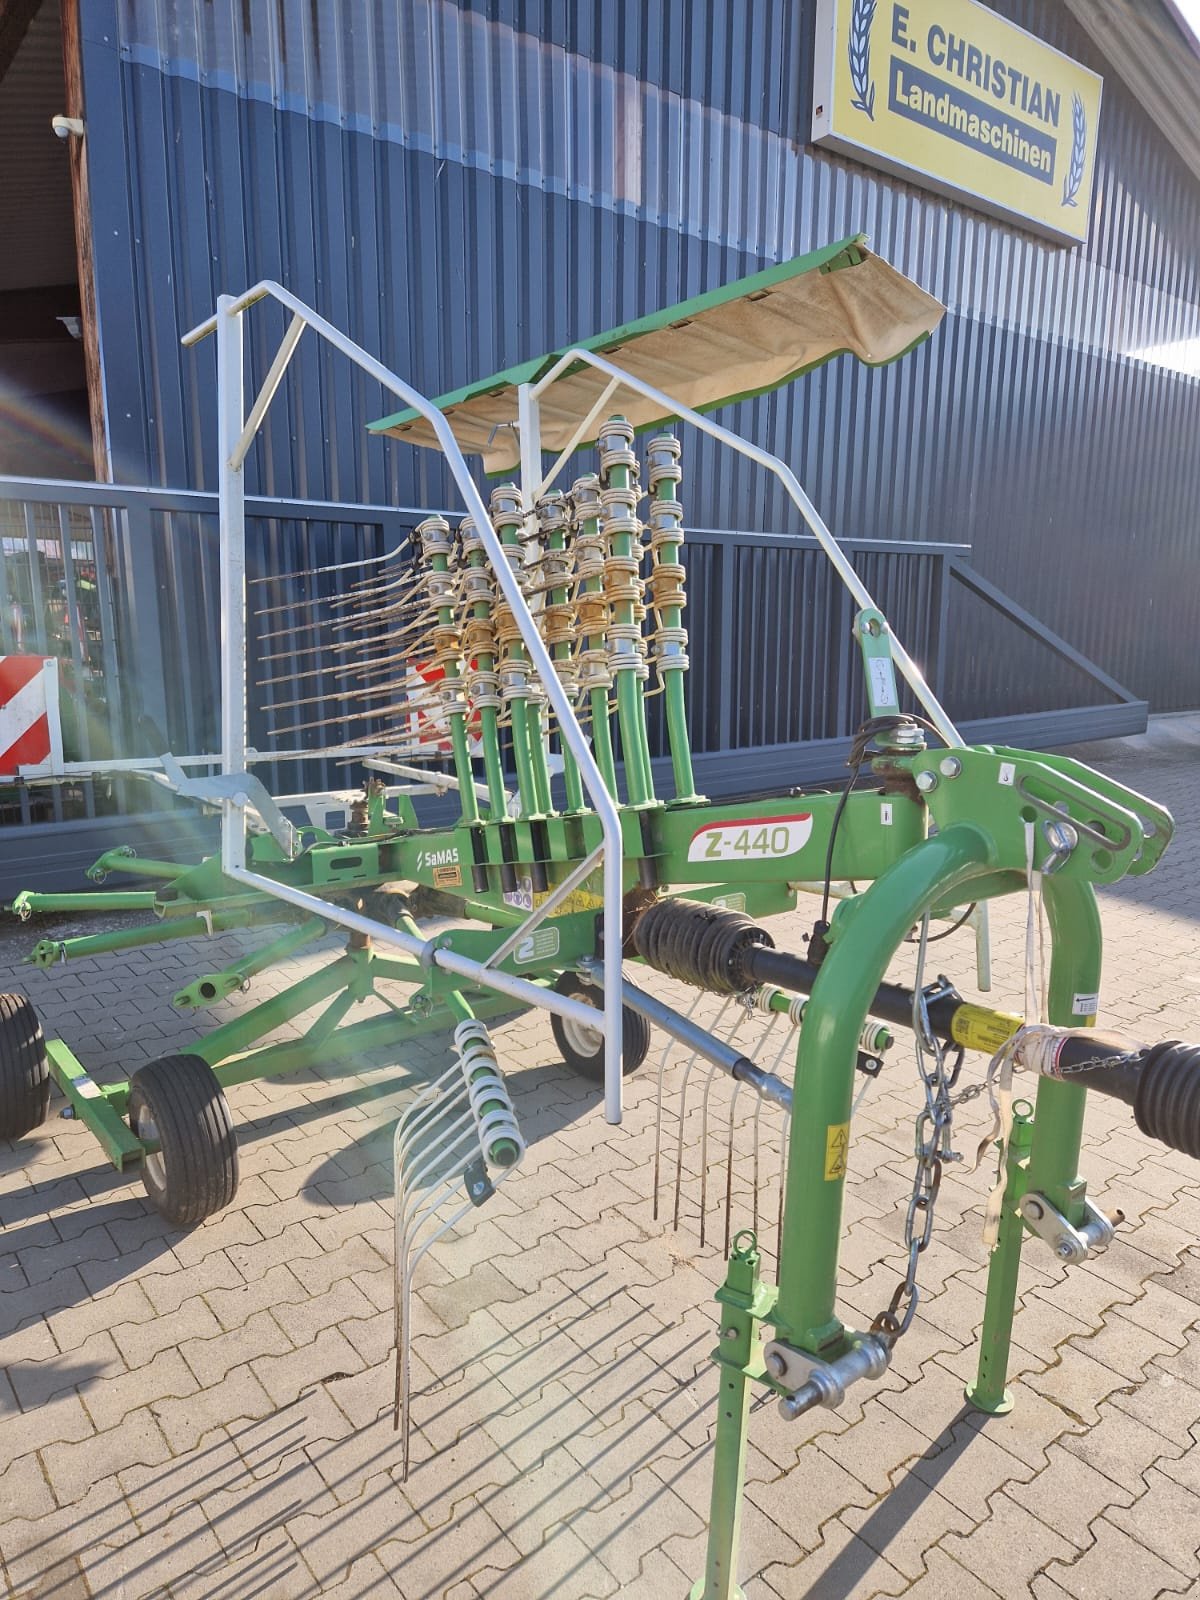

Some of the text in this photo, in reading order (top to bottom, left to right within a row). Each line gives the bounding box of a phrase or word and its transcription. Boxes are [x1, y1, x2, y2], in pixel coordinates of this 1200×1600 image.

[891, 3, 1061, 128] E. CHRISTIAN
[896, 70, 1051, 173] Landmaschinen
[705, 826, 790, 858] Z-440
